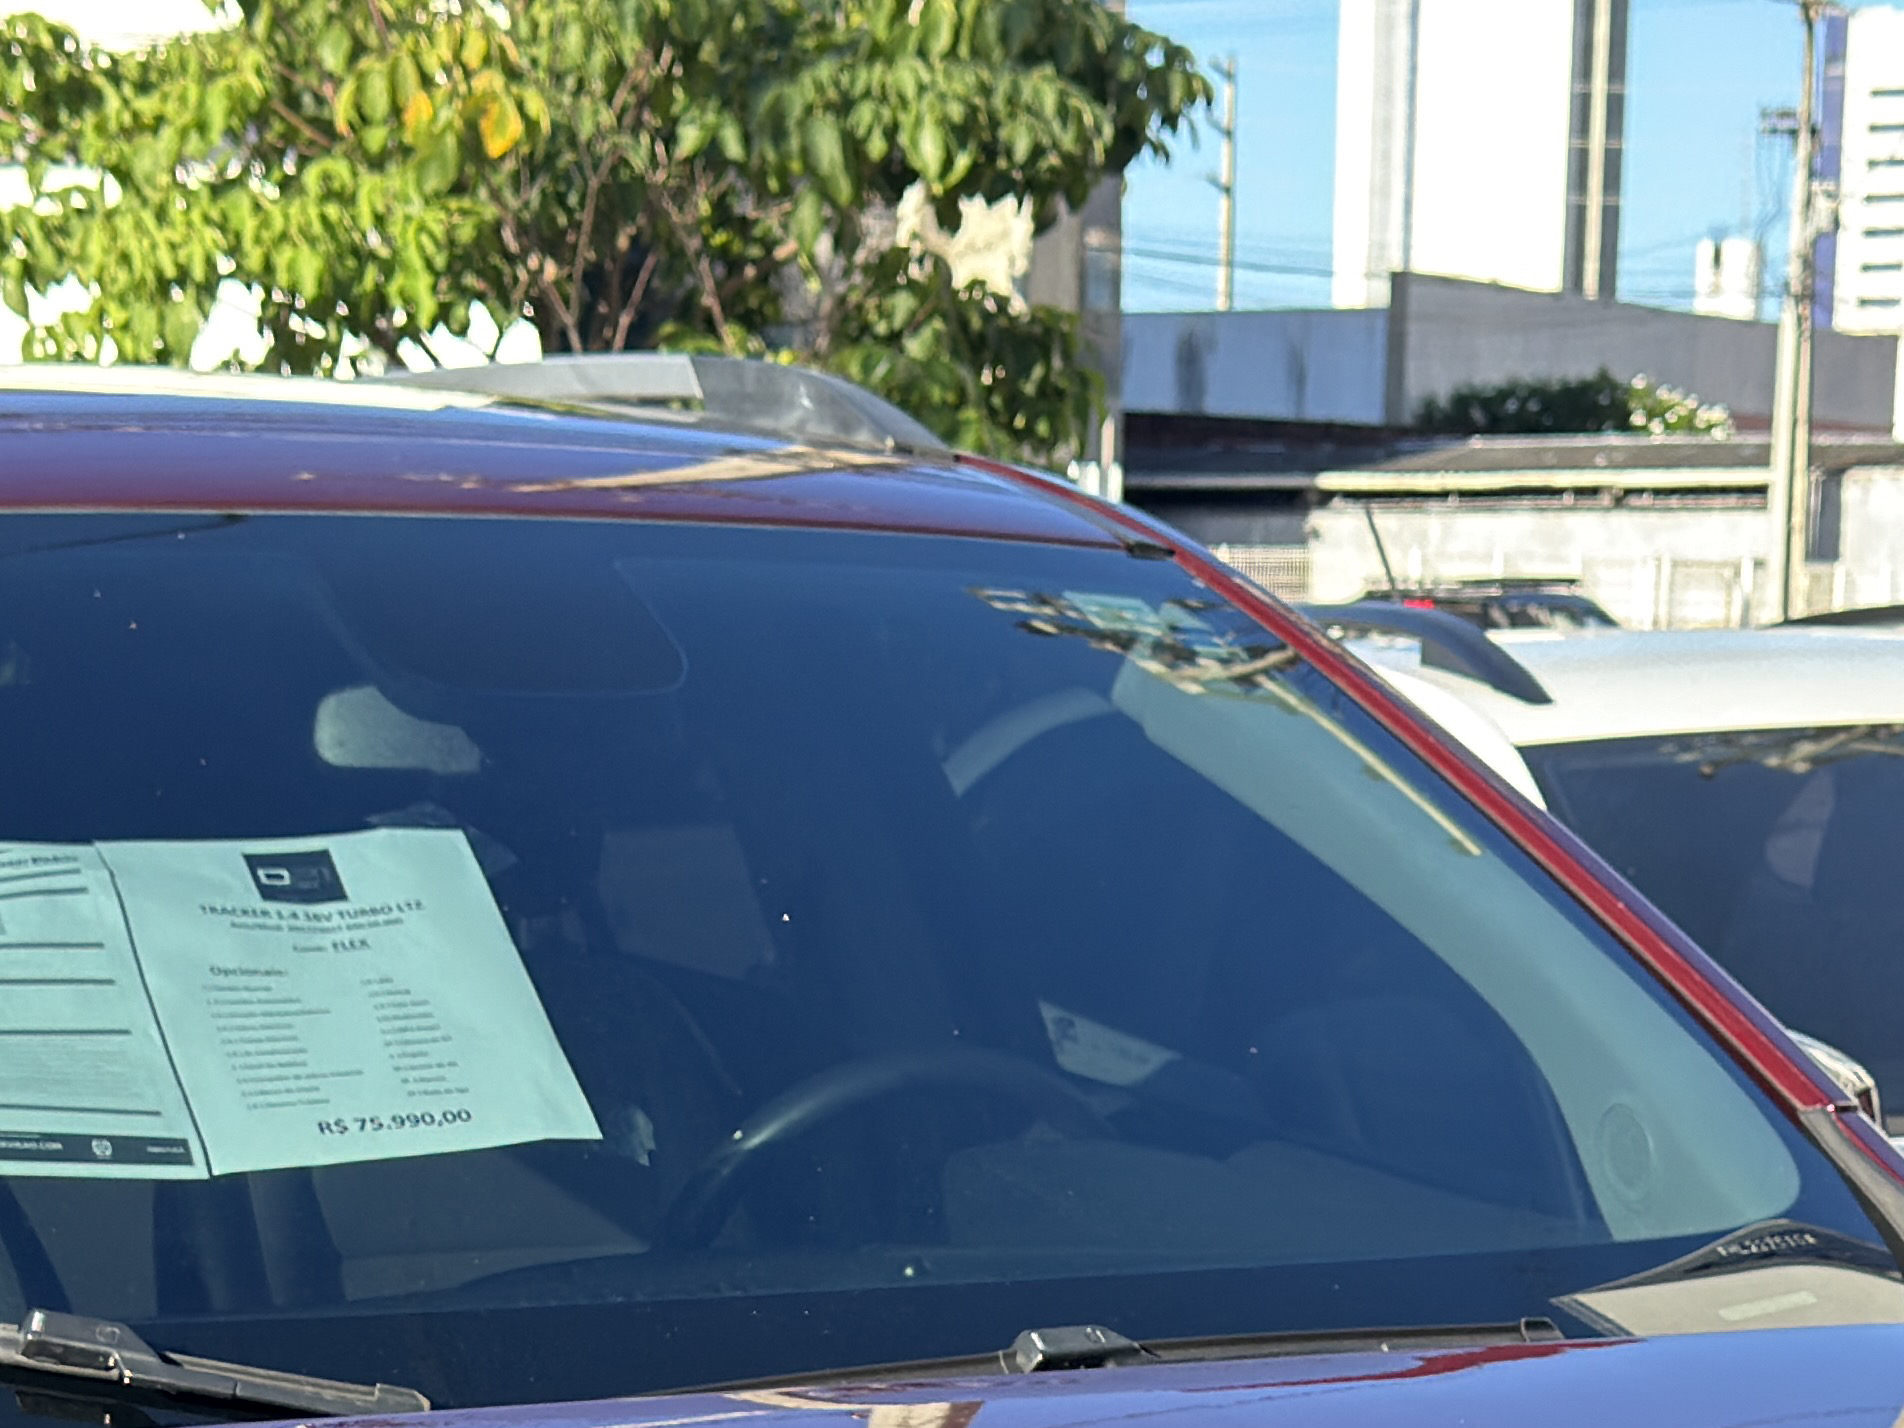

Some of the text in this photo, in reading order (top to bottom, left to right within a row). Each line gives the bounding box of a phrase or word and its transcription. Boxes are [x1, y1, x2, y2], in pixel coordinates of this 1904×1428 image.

[199, 903, 273, 920] TRACKER
[317, 1108, 473, 1136] R$ 75.990,00
